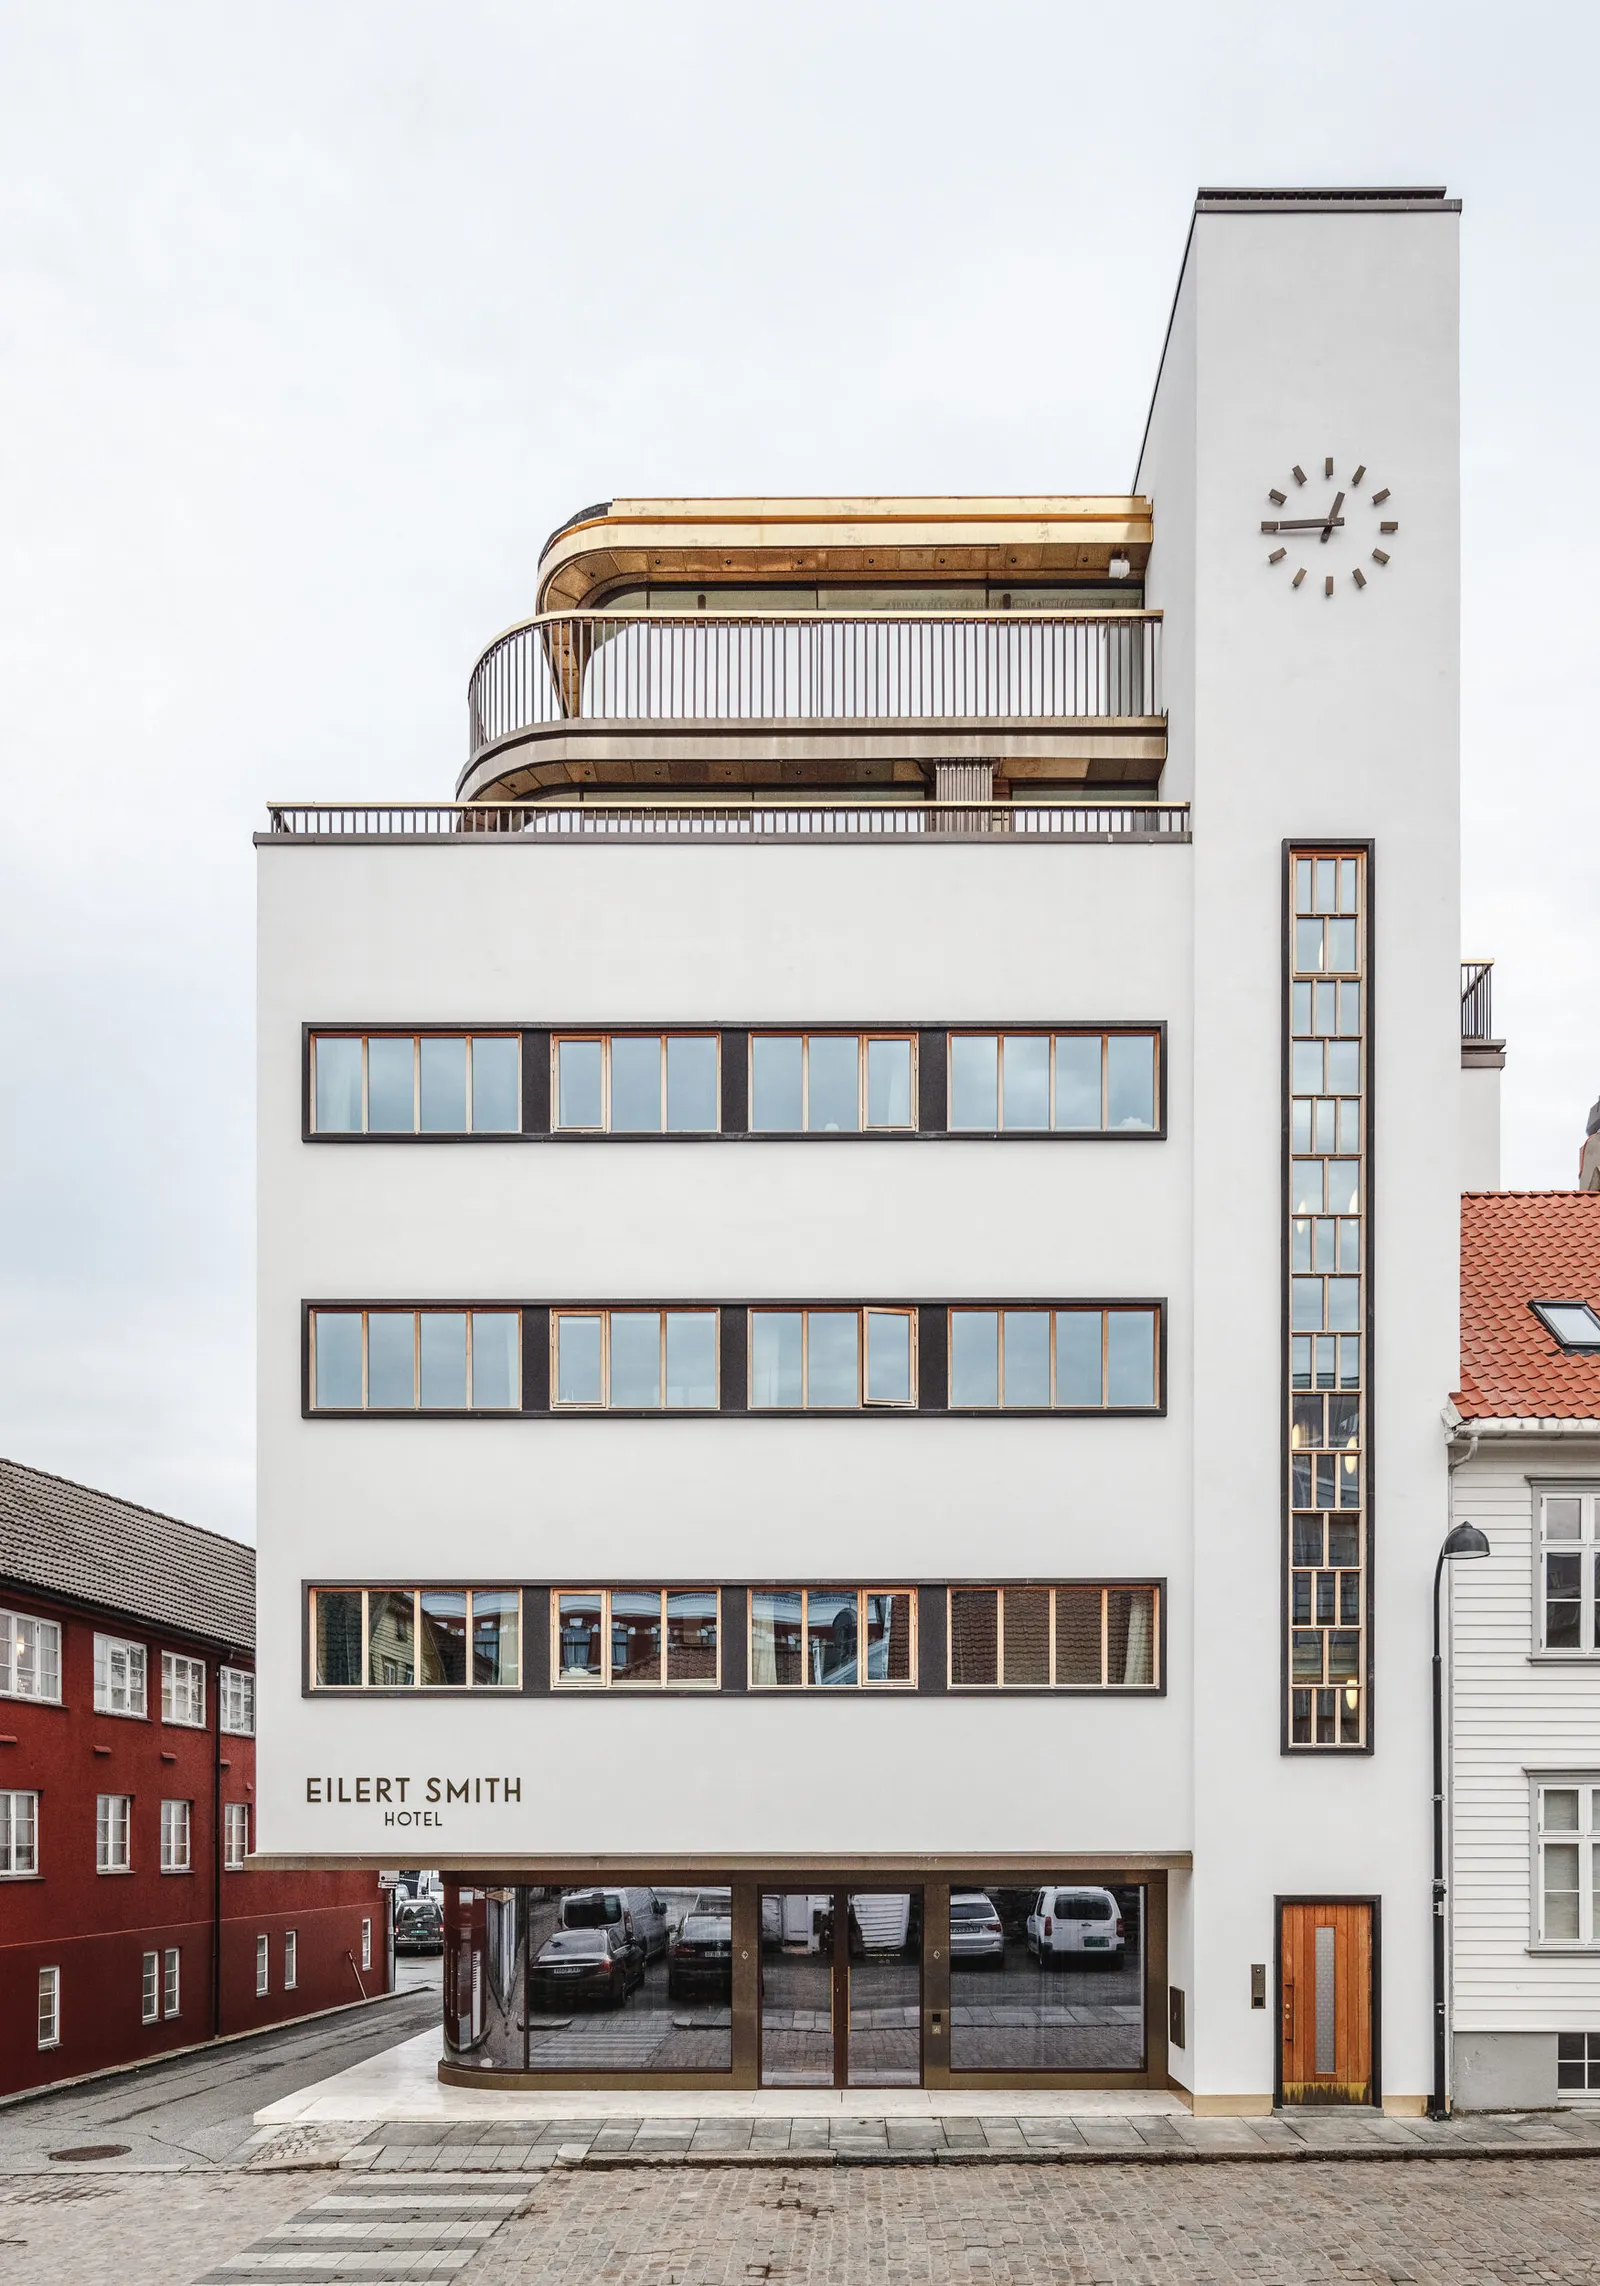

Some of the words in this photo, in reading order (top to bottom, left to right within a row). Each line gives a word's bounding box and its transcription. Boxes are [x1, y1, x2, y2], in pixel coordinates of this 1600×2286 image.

[306, 1777, 410, 1803] EILERT
[425, 1777, 521, 1803] SMITH
[384, 1811, 442, 1826] HOTEL
